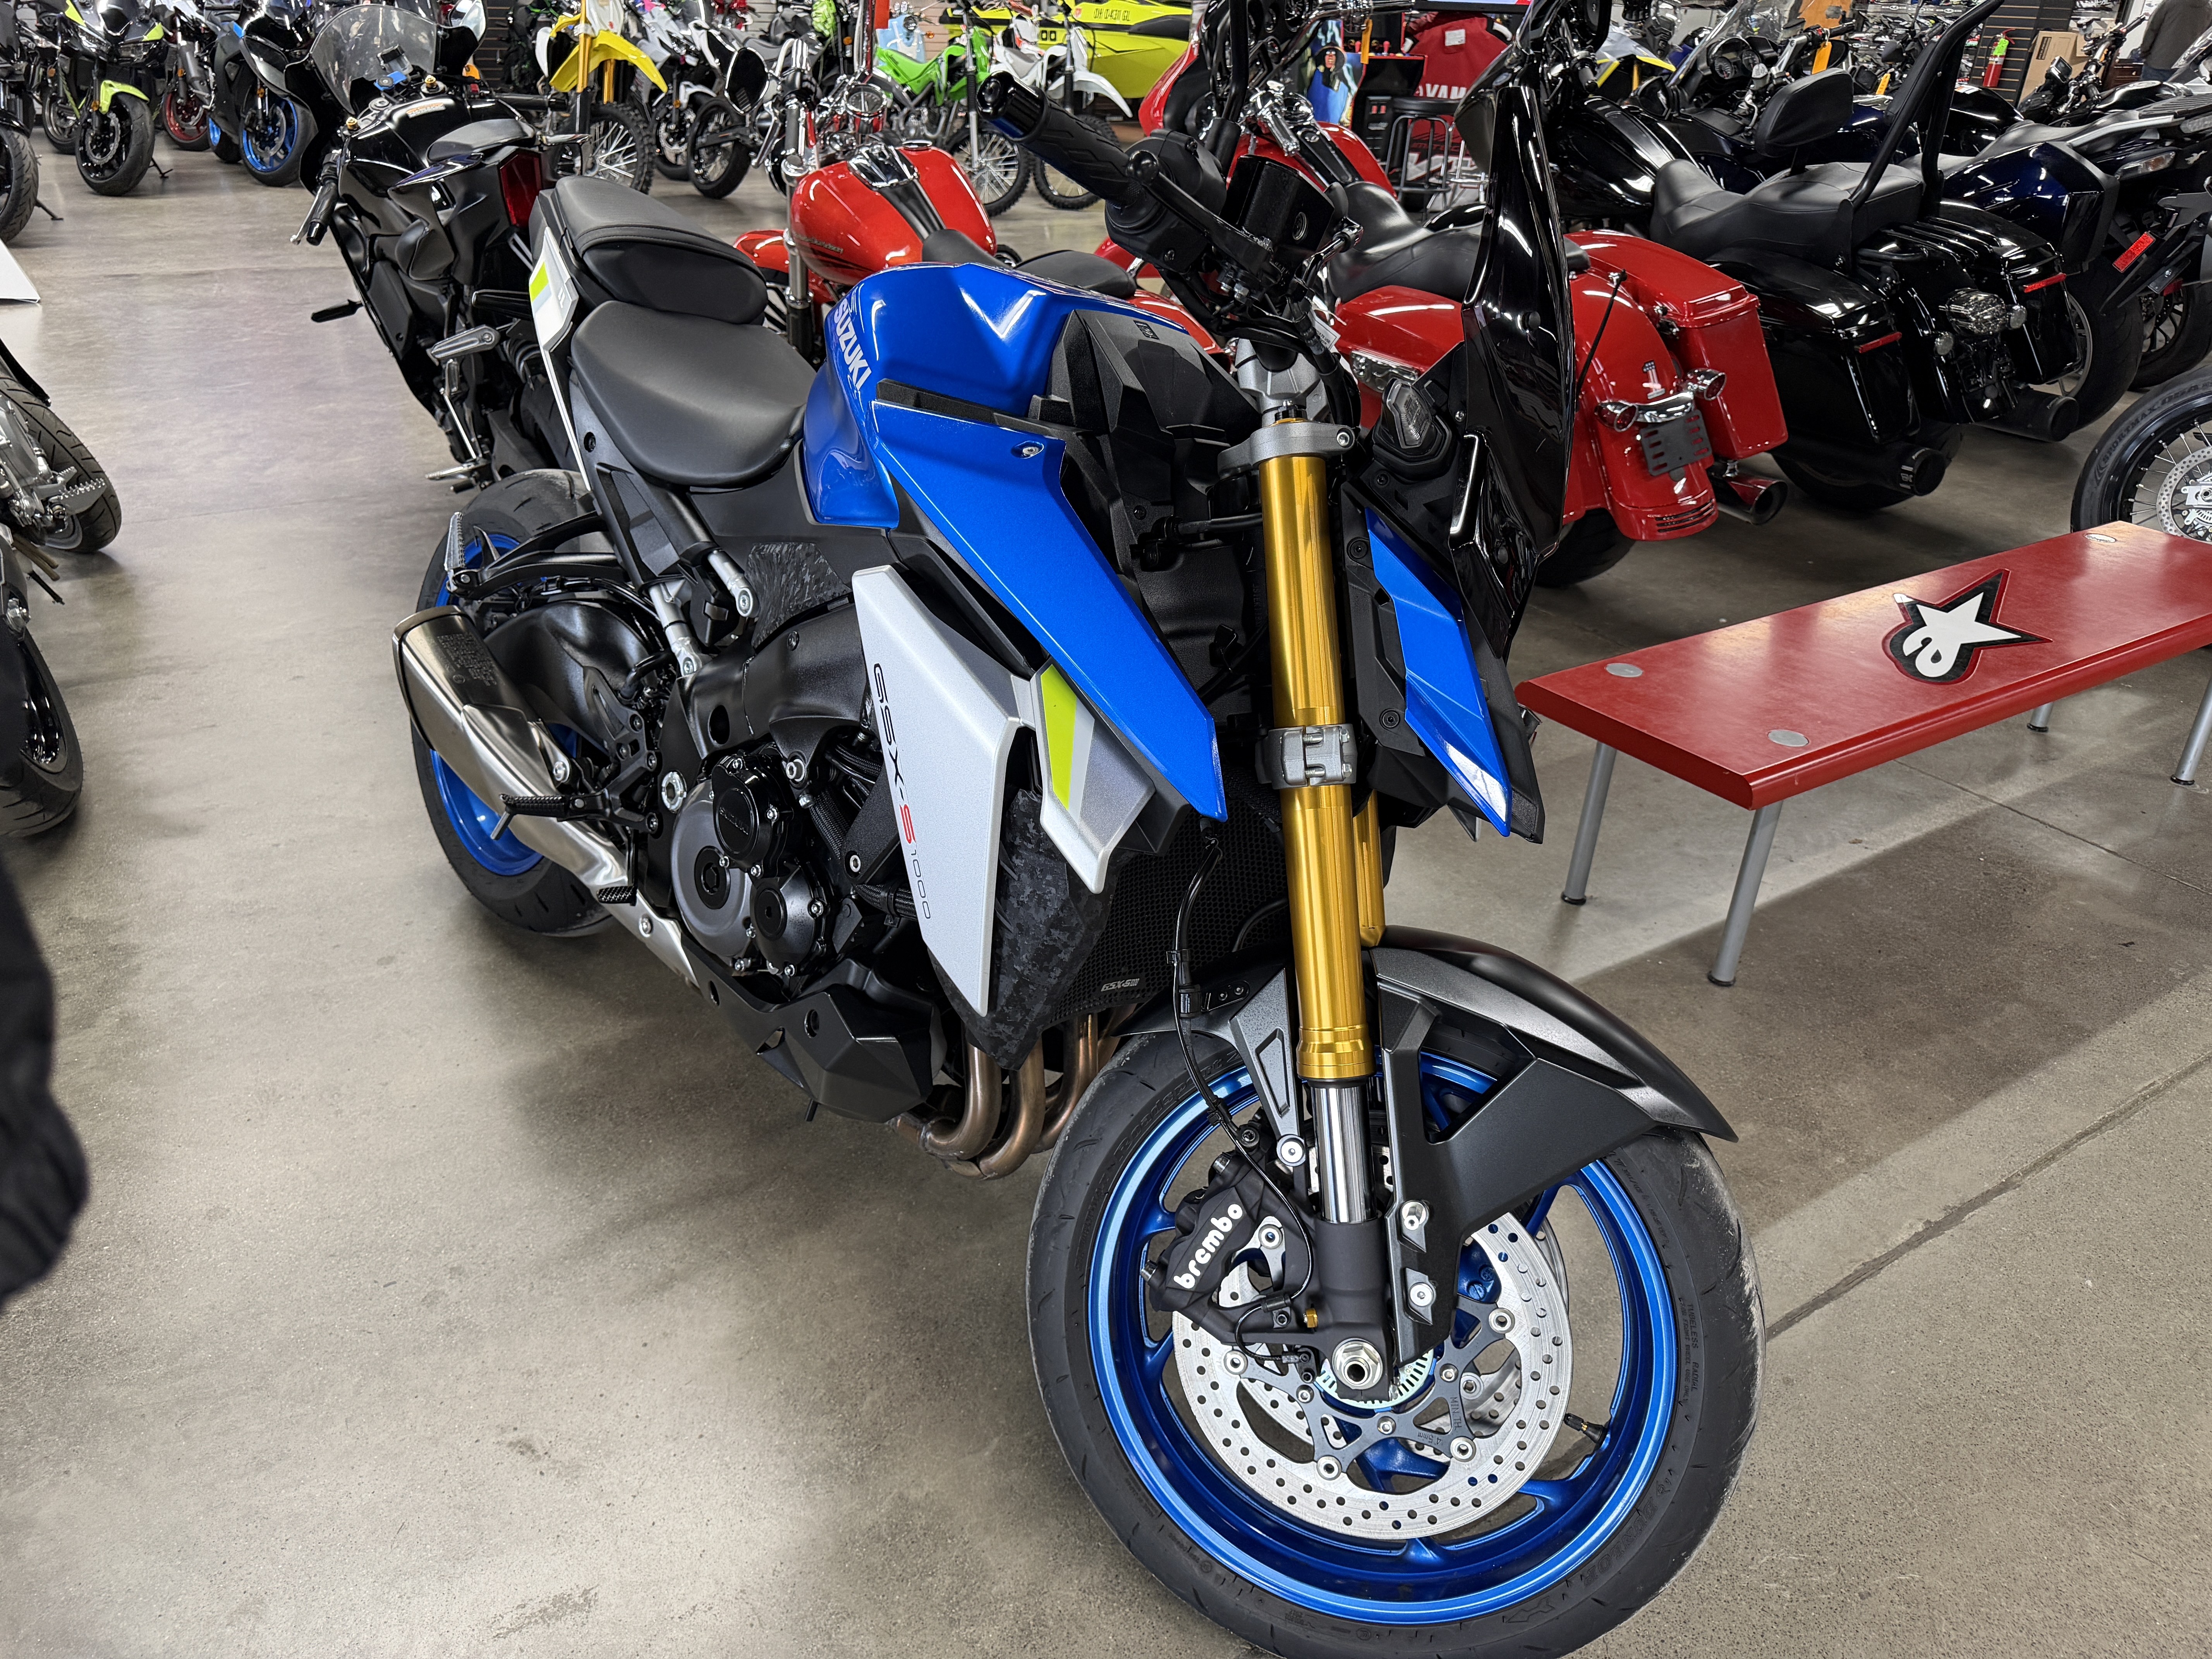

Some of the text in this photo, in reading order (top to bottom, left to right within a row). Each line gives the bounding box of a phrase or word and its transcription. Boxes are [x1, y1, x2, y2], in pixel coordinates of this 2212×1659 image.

[834, 298, 872, 391] SUZUKI
[1173, 1204, 1243, 1289] brembo
[1687, 1304, 1699, 1392] TUBELESS RADIAL
